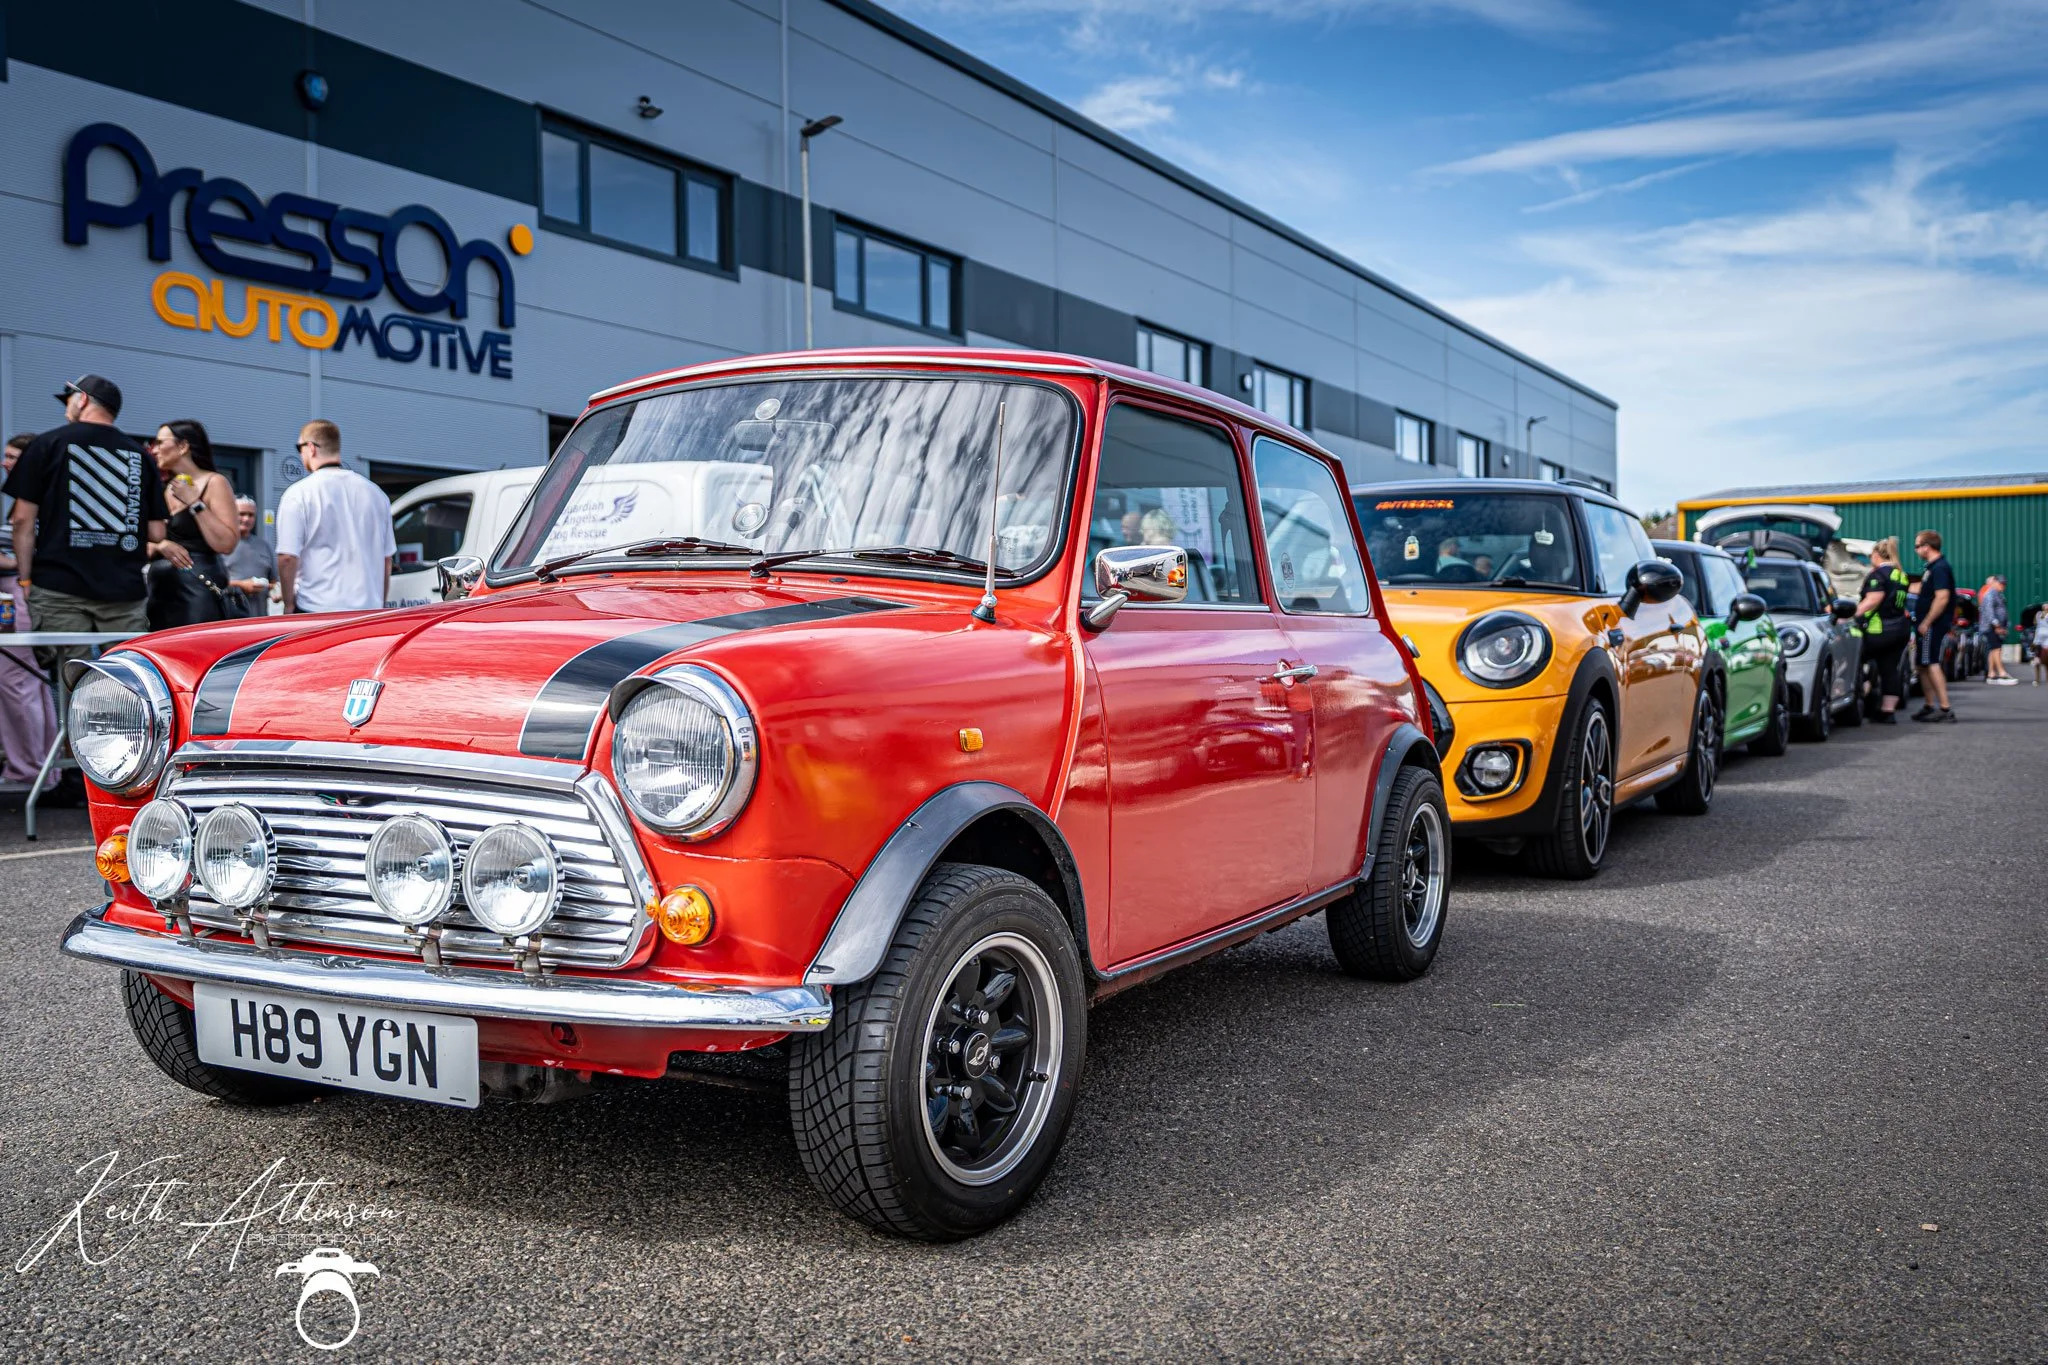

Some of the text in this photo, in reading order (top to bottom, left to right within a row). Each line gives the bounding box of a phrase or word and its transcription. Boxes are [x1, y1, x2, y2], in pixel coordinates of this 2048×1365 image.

[125, 451, 142, 533] EUROSTANCE
[571, 527, 608, 538] Rescue
[349, 680, 380, 697] MINI
[231, 998, 438, 1089] H89 YGN
